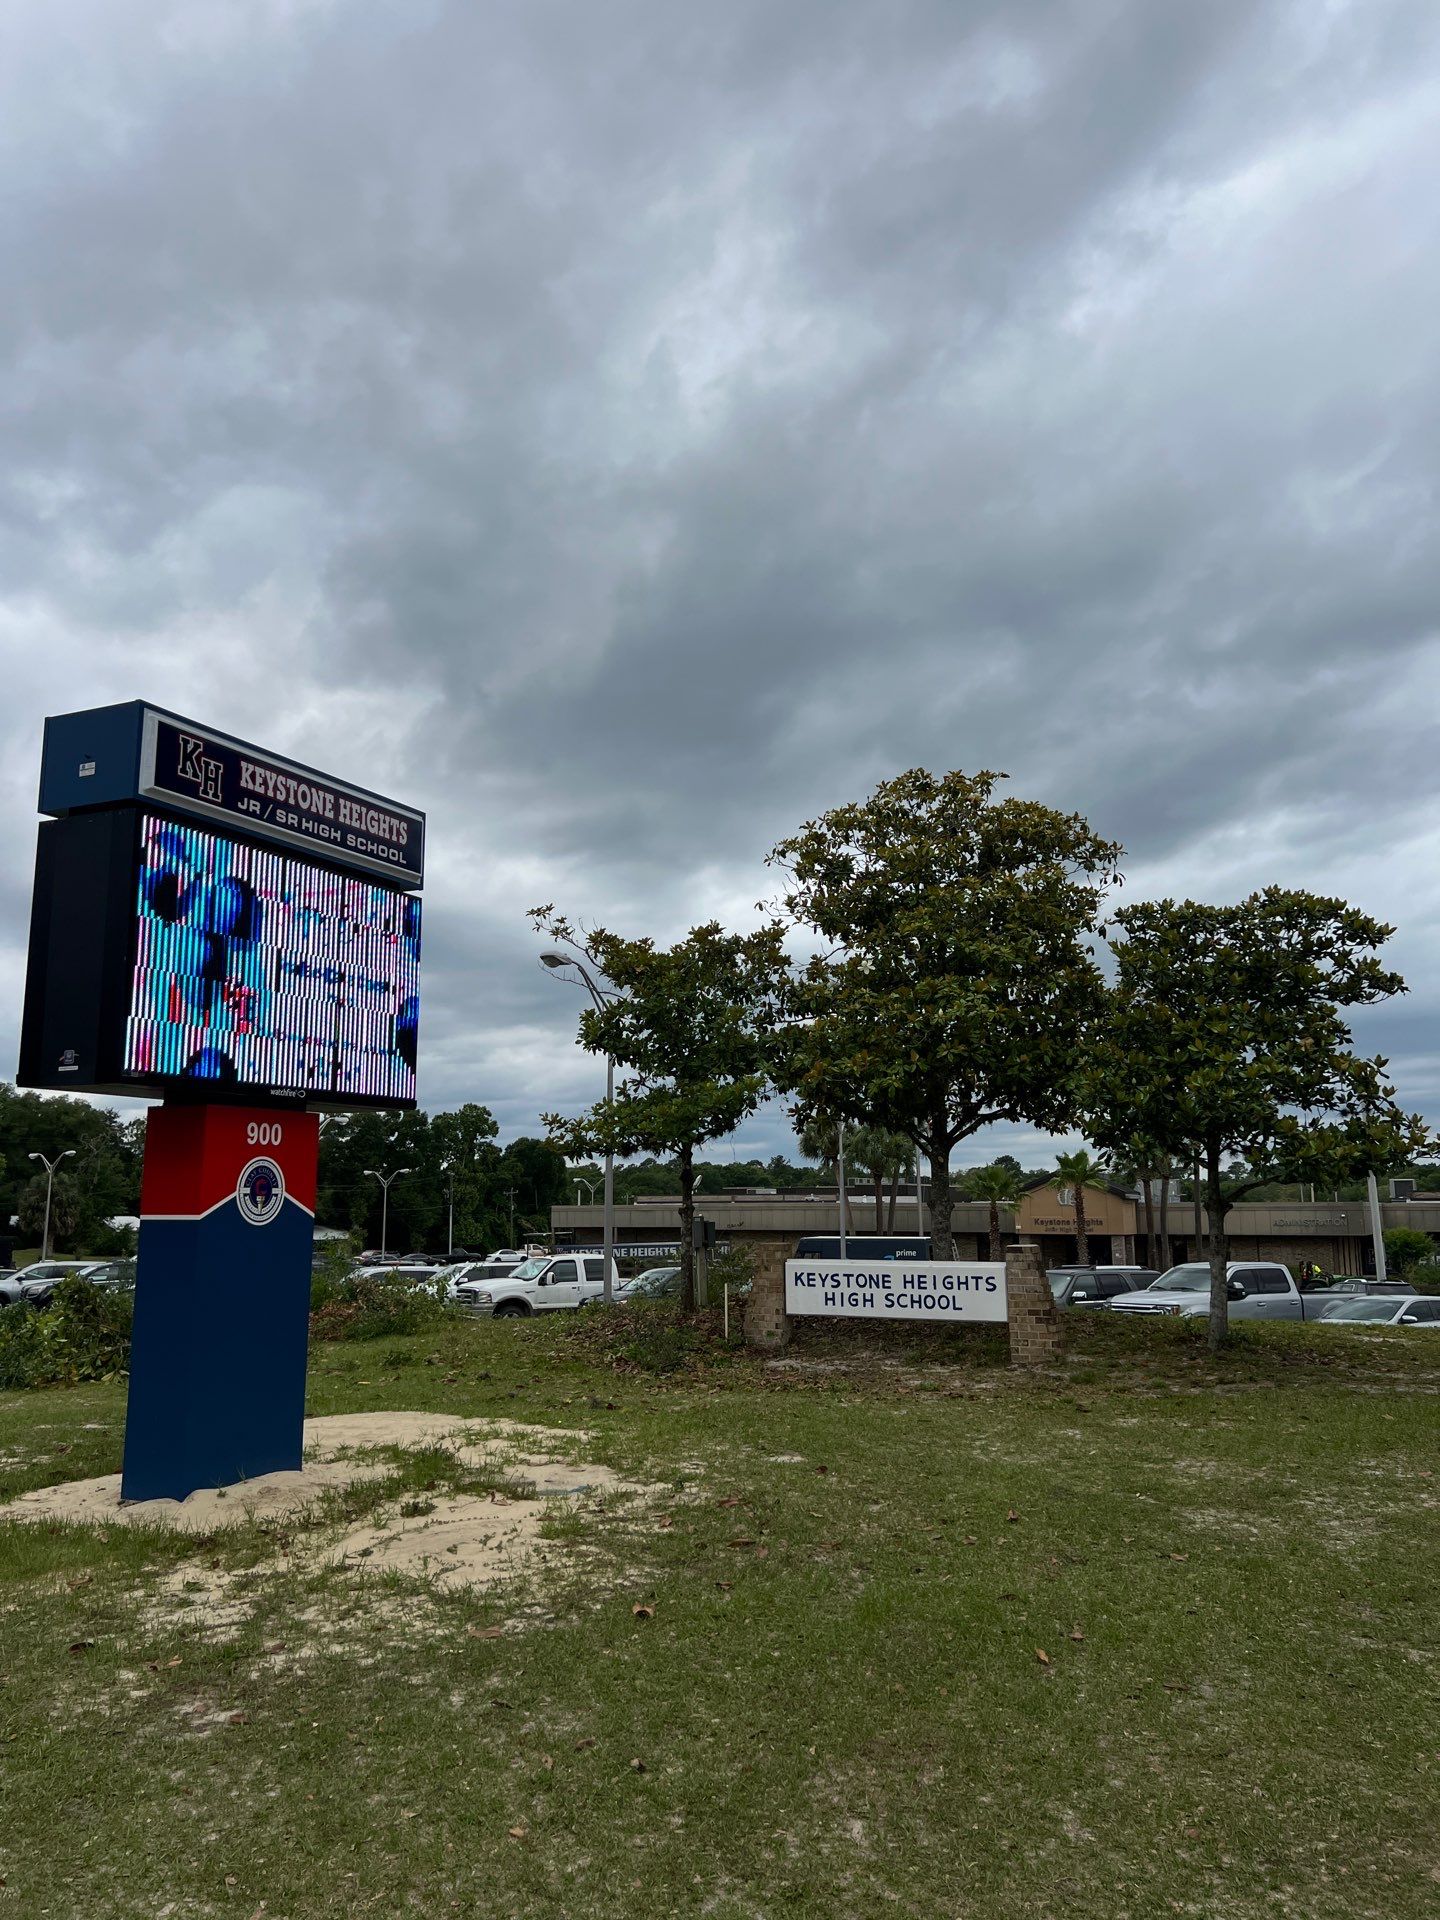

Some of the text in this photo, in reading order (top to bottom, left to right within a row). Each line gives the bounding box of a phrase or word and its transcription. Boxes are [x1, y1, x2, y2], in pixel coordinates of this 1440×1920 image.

[240, 760, 408, 845] KEYSTONE HEIGHTS
[301, 817, 341, 842] HIGH
[346, 833, 407, 865] SCHOOL
[270, 1088, 296, 1098] watchfire
[247, 1122, 282, 1146] 900
[258, 1167, 277, 1186] COUNTY
[630, 1246, 677, 1257] HEIGHTS
[895, 1249, 917, 1258] prime
[794, 1271, 997, 1292] KEYSTONE HEIGHTS
[824, 1292, 963, 1311] HIGH SCHOOL
